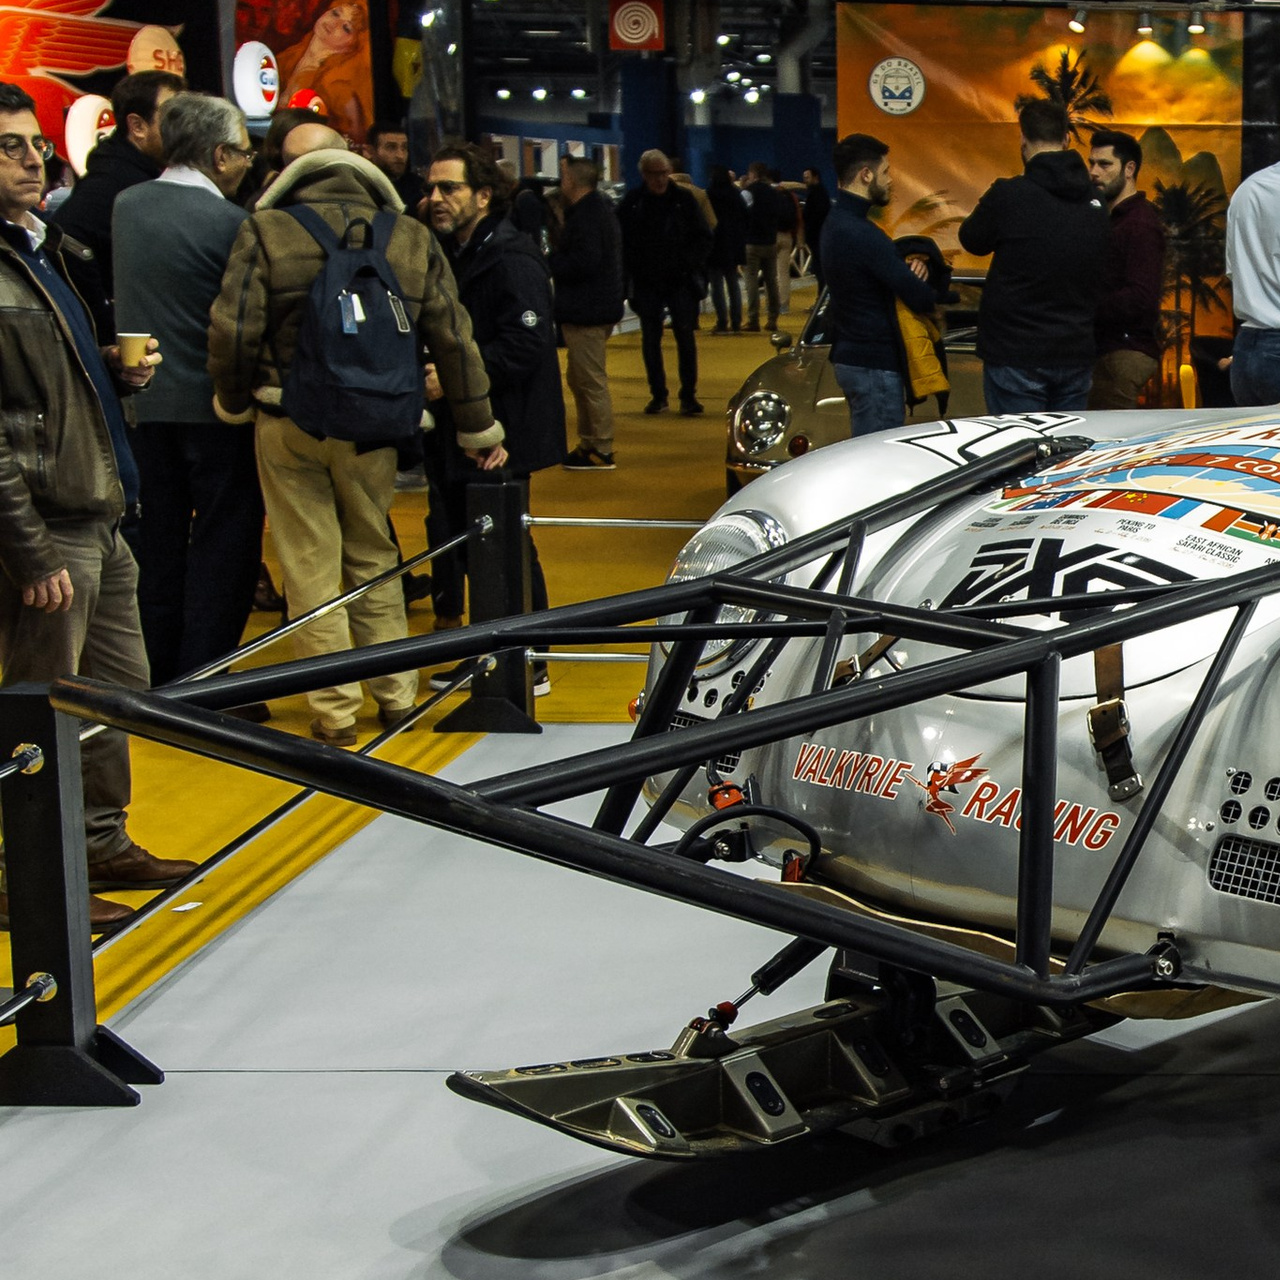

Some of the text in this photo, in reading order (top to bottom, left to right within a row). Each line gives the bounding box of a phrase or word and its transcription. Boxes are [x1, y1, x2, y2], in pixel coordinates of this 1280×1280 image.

[1205, 456, 1227, 466] 7
[1175, 538, 1206, 554] SAFARI
[1203, 546, 1241, 565] CLASSIC
[1185, 533, 1244, 557] EAST AFRICAN
[793, 742, 1121, 851] VALKYRIE RAING
